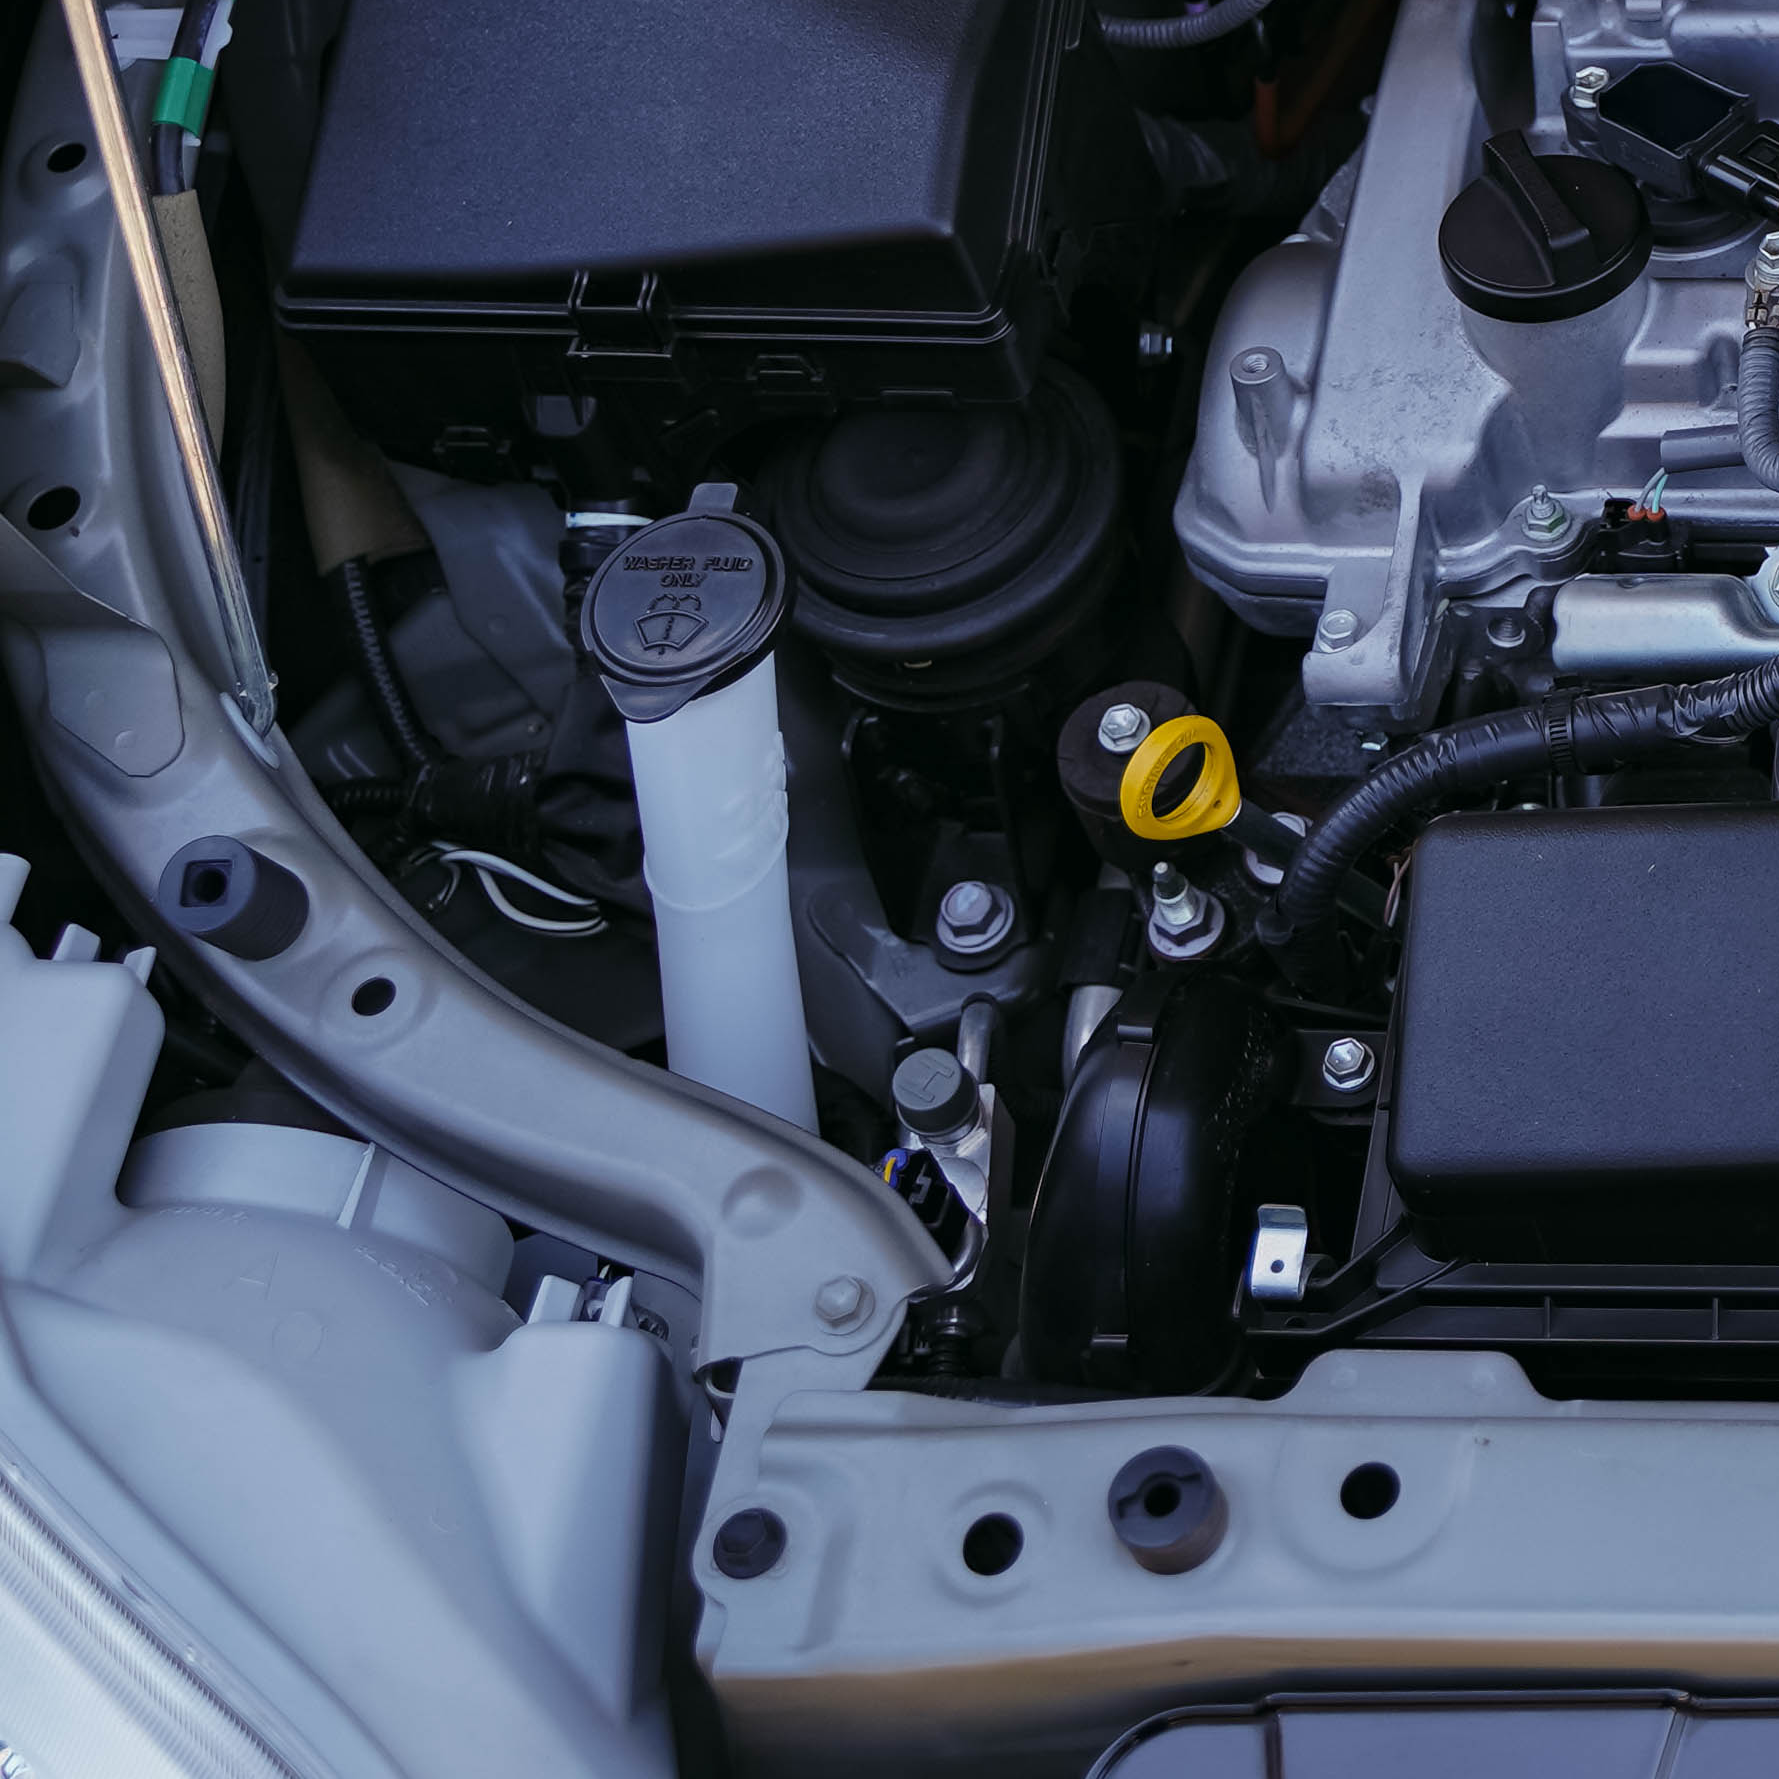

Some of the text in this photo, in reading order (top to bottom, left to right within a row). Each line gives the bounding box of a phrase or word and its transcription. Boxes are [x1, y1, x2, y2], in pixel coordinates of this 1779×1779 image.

[623, 555, 753, 572] WASHER FLUID
[660, 572, 707, 588] ONLY
